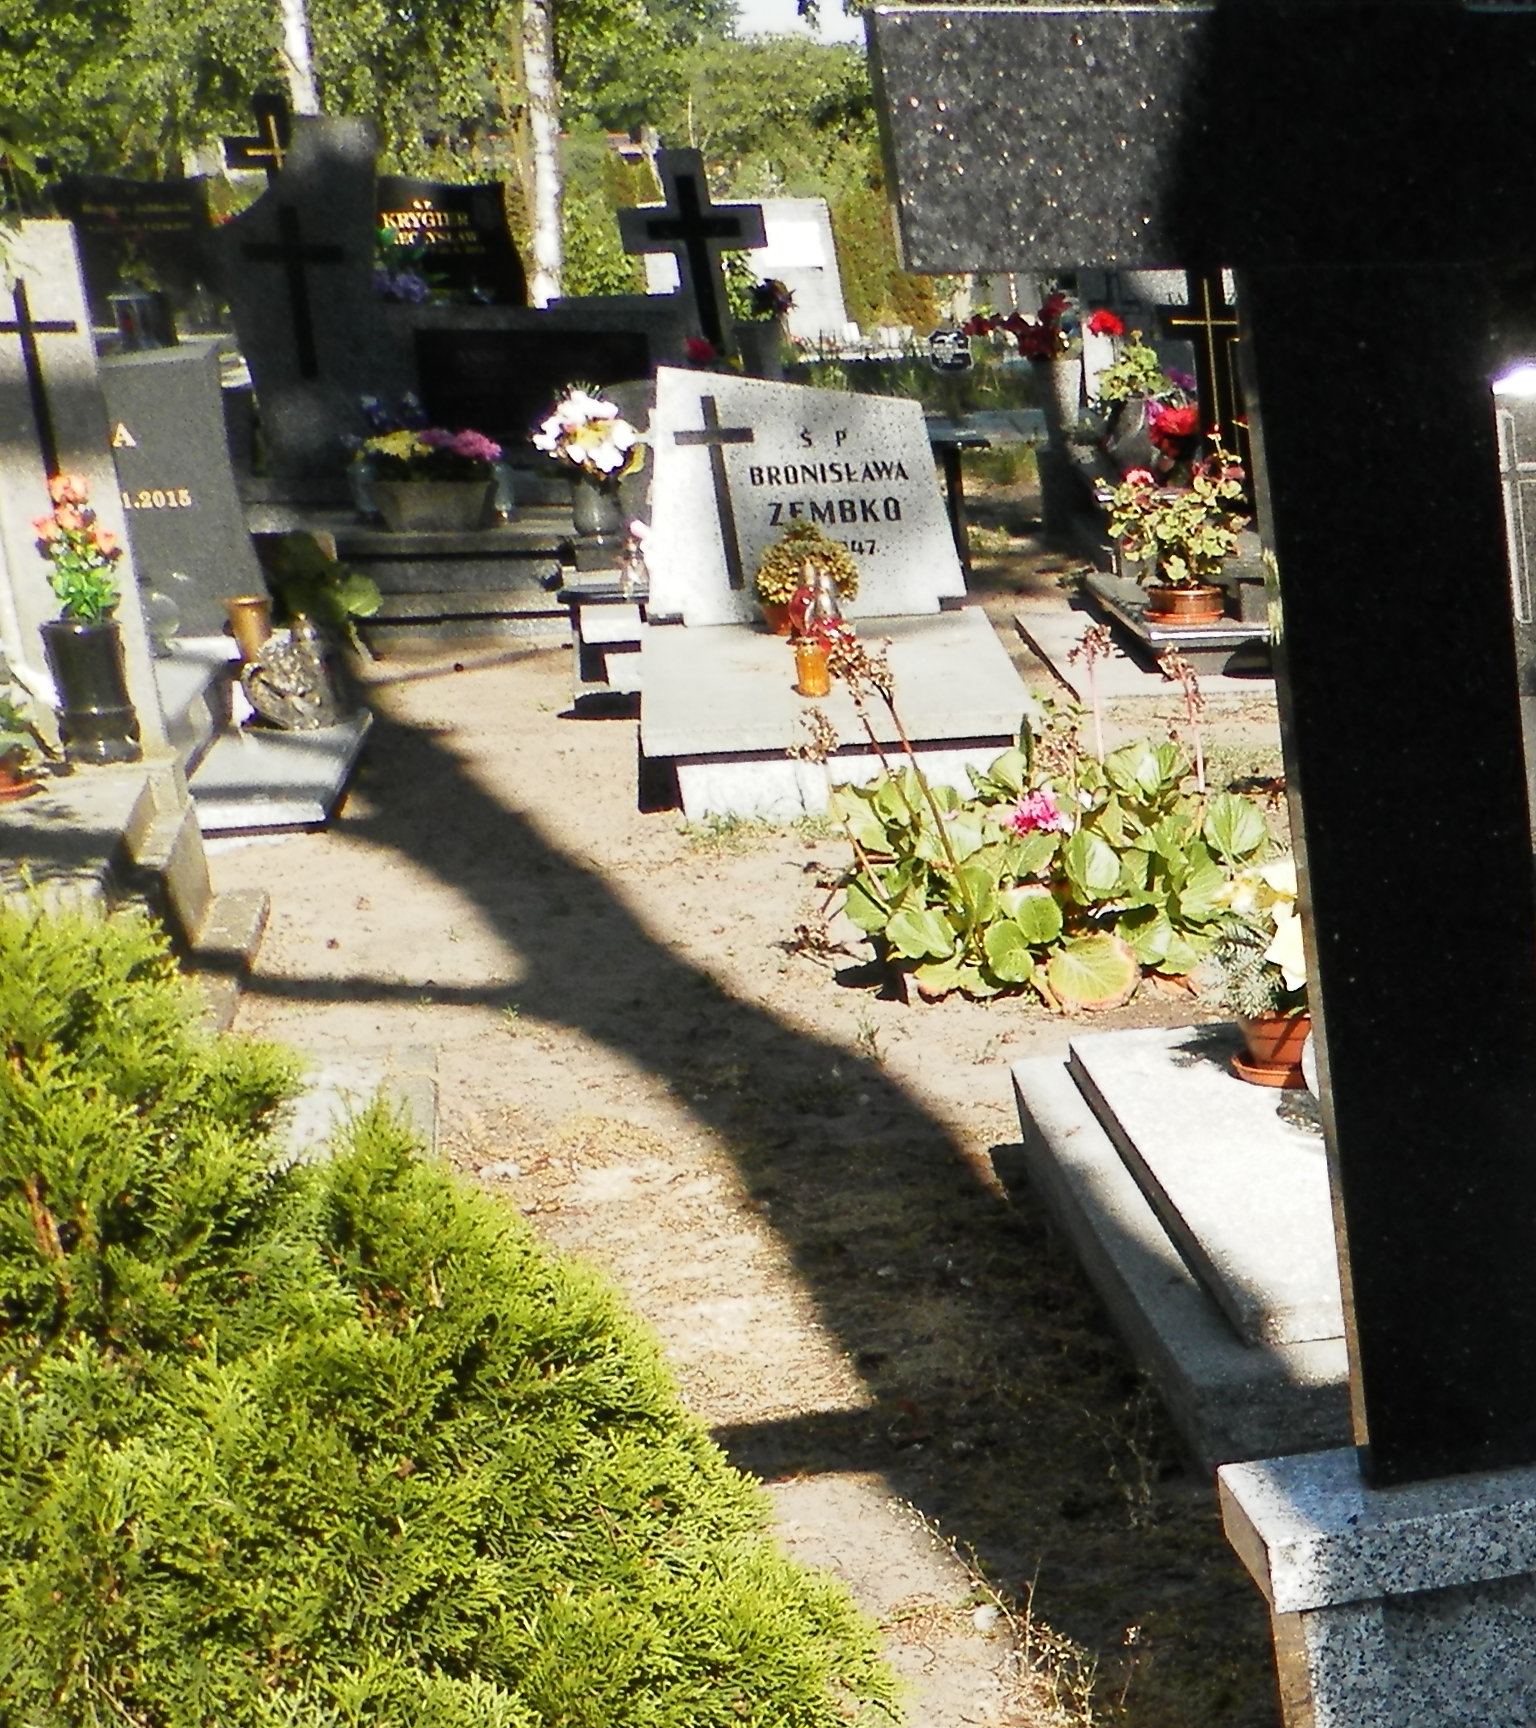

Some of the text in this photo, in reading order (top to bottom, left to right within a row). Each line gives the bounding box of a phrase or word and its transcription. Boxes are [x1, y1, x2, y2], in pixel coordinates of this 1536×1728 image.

[749, 460, 909, 486] BRONISŁAWA
[122, 487, 192, 509] 1.2015
[767, 497, 902, 527] ZEMBKO
